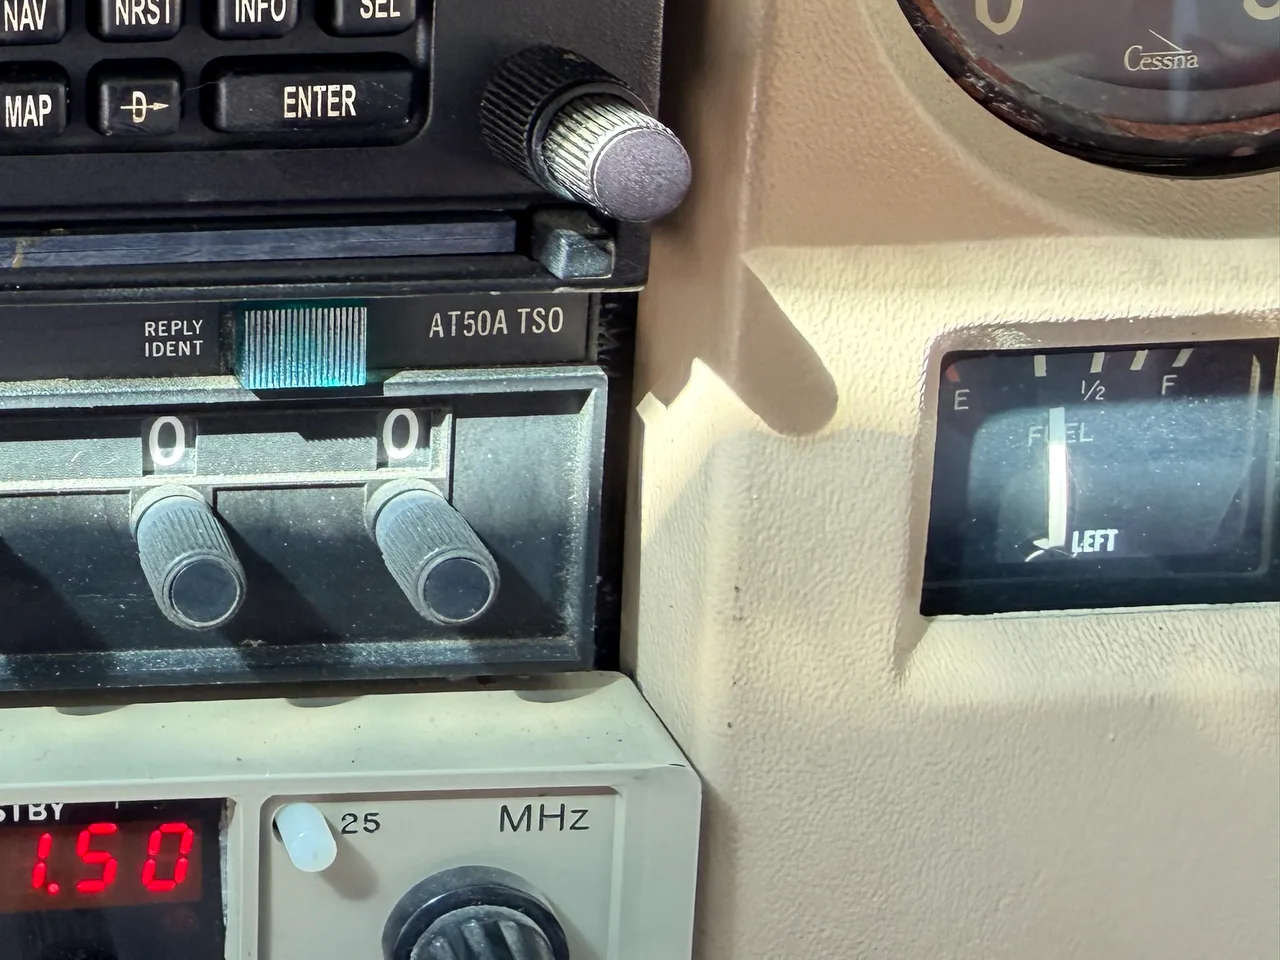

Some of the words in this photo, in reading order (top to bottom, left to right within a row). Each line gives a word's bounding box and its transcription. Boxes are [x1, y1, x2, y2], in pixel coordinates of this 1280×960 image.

[1124, 45, 1200, 72] Cessna
[4, 93, 53, 128] MAP
[282, 83, 357, 120] ENTER
[144, 321, 204, 339] REPLY
[429, 309, 508, 338] AT50A
[517, 306, 564, 334] TSO
[144, 341, 204, 358] IDENT
[1161, 375, 1177, 396] F
[953, 389, 970, 411] E
[148, 417, 185, 466] 0
[382, 408, 419, 458] 0
[1028, 422, 1094, 446] FEL
[1071, 529, 1119, 553] LEFT
[341, 813, 381, 834] 25
[499, 805, 590, 833] MHz
